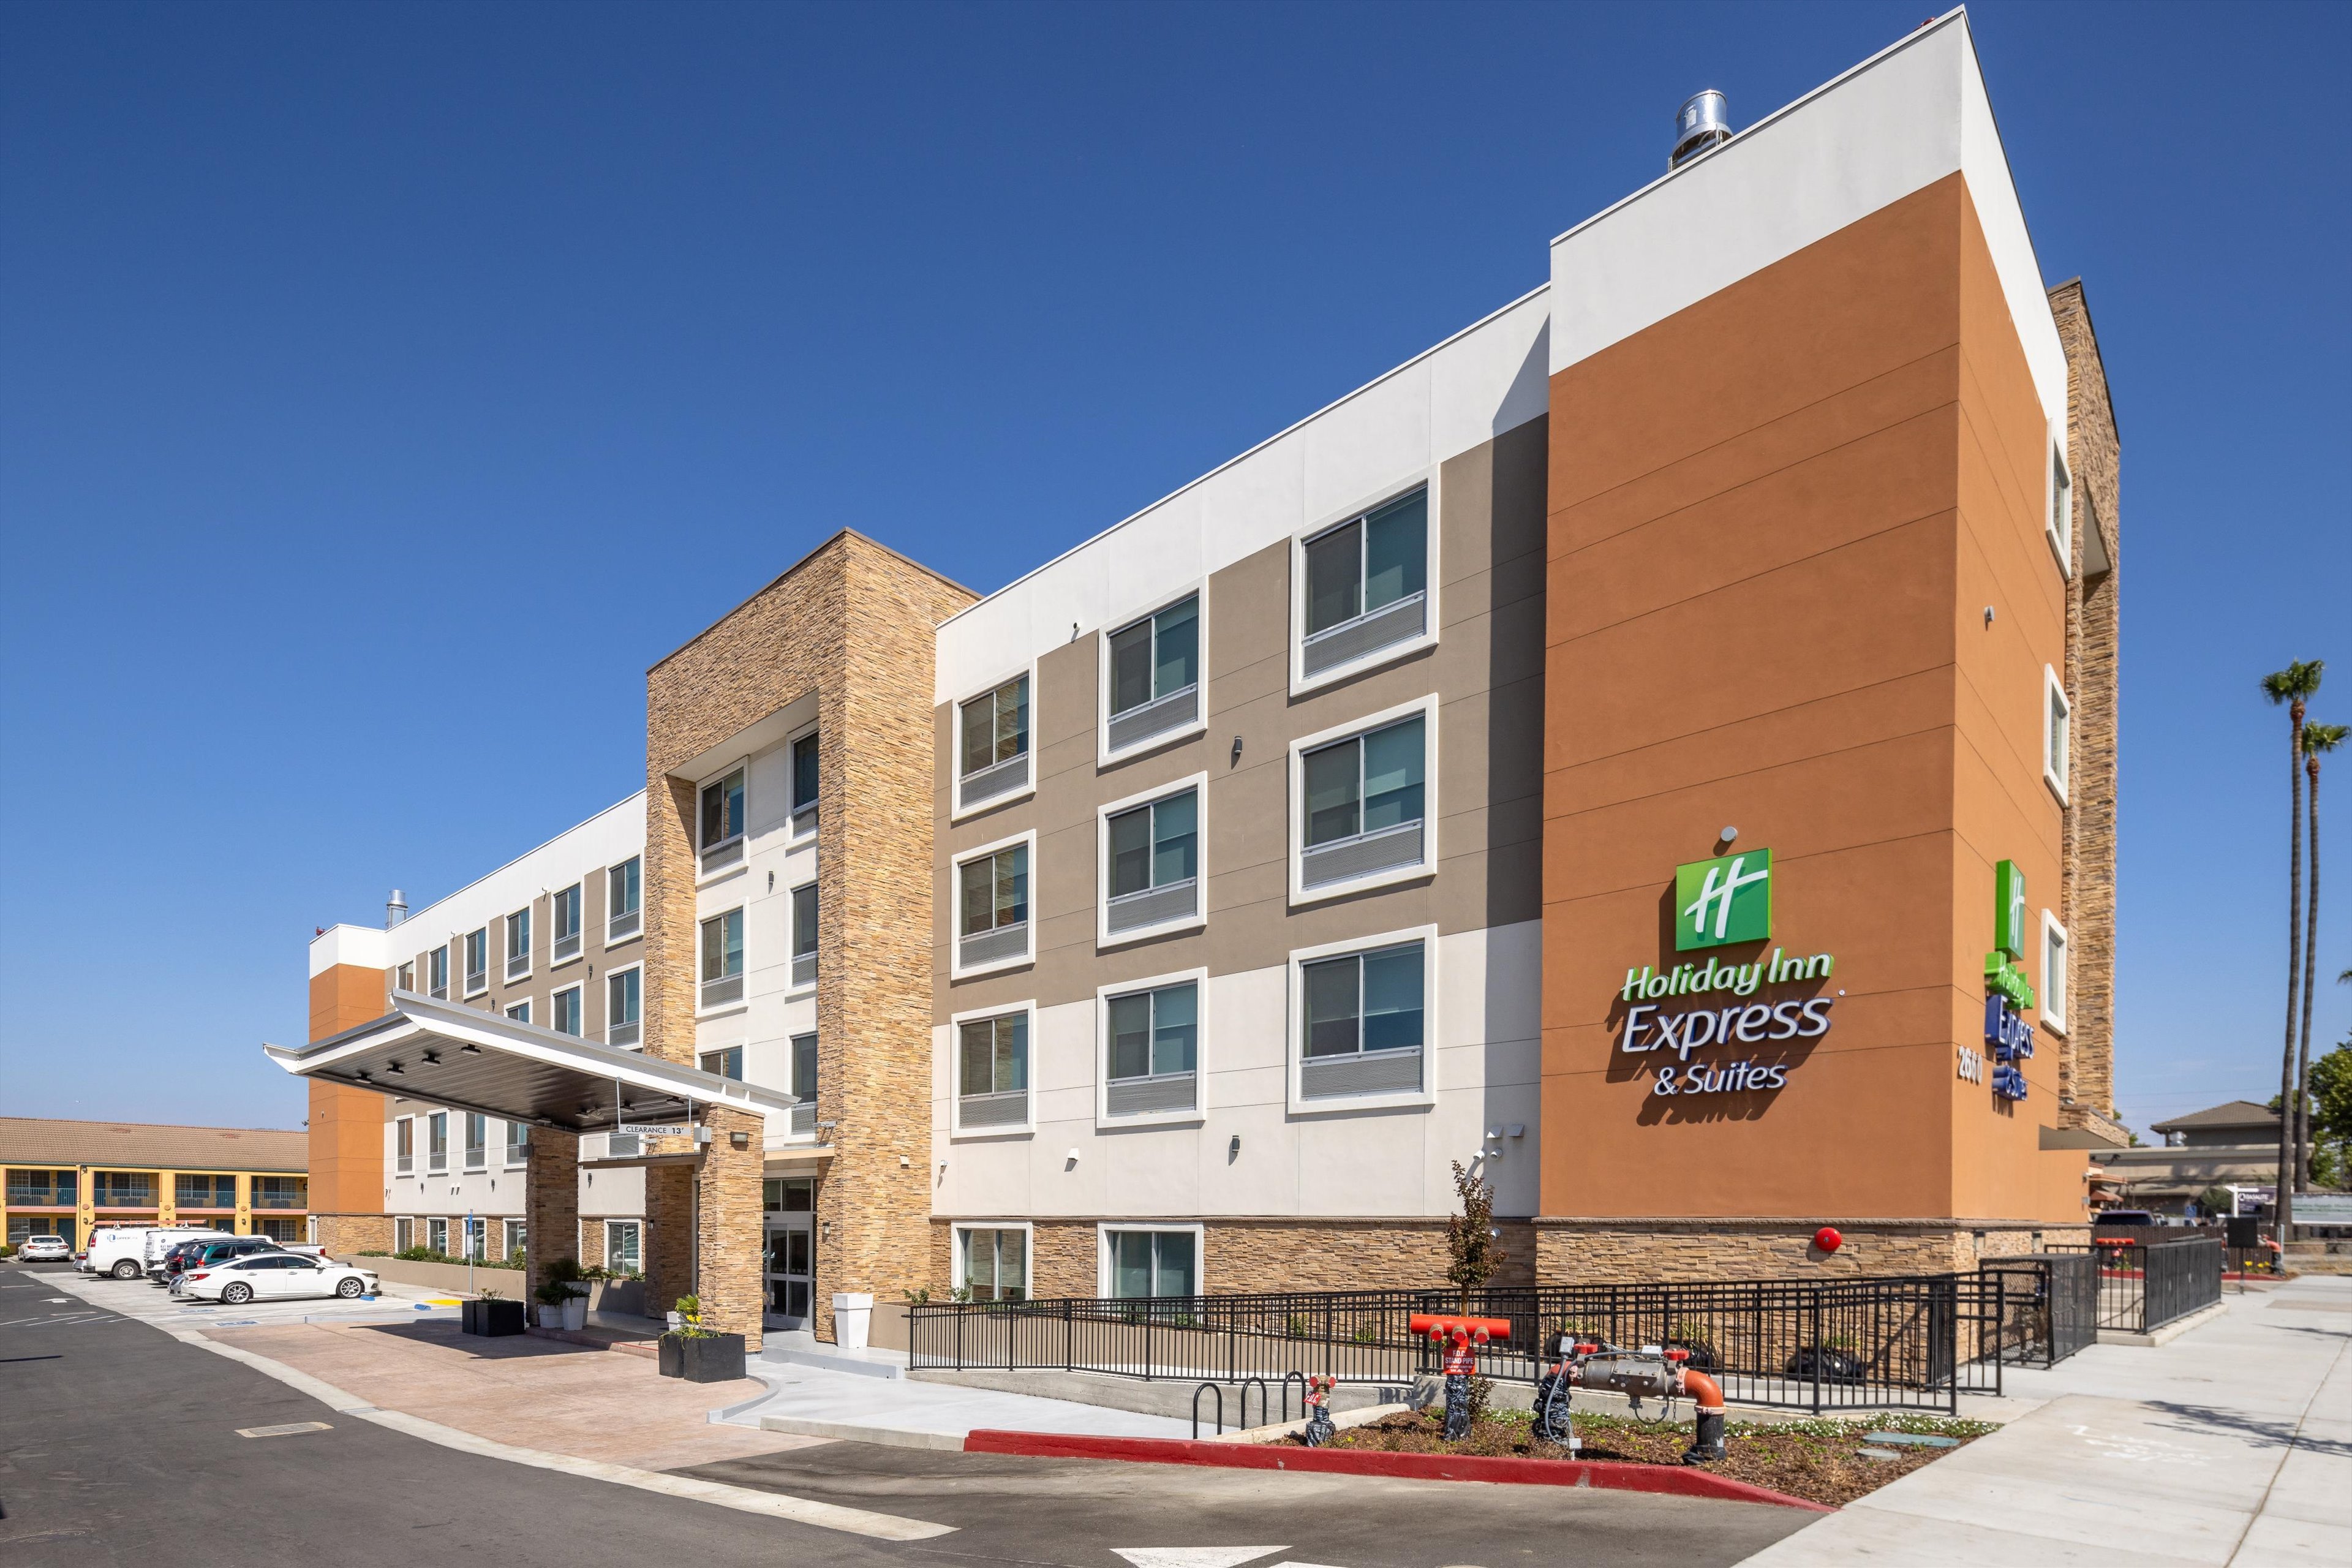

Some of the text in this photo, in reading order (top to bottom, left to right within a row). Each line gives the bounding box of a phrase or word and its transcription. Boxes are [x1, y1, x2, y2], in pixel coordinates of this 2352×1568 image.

[1620, 946, 1834, 1001] Holiday Inn
[1622, 997, 1833, 1061] Express
[1654, 1061, 1789, 1095] & Suites
